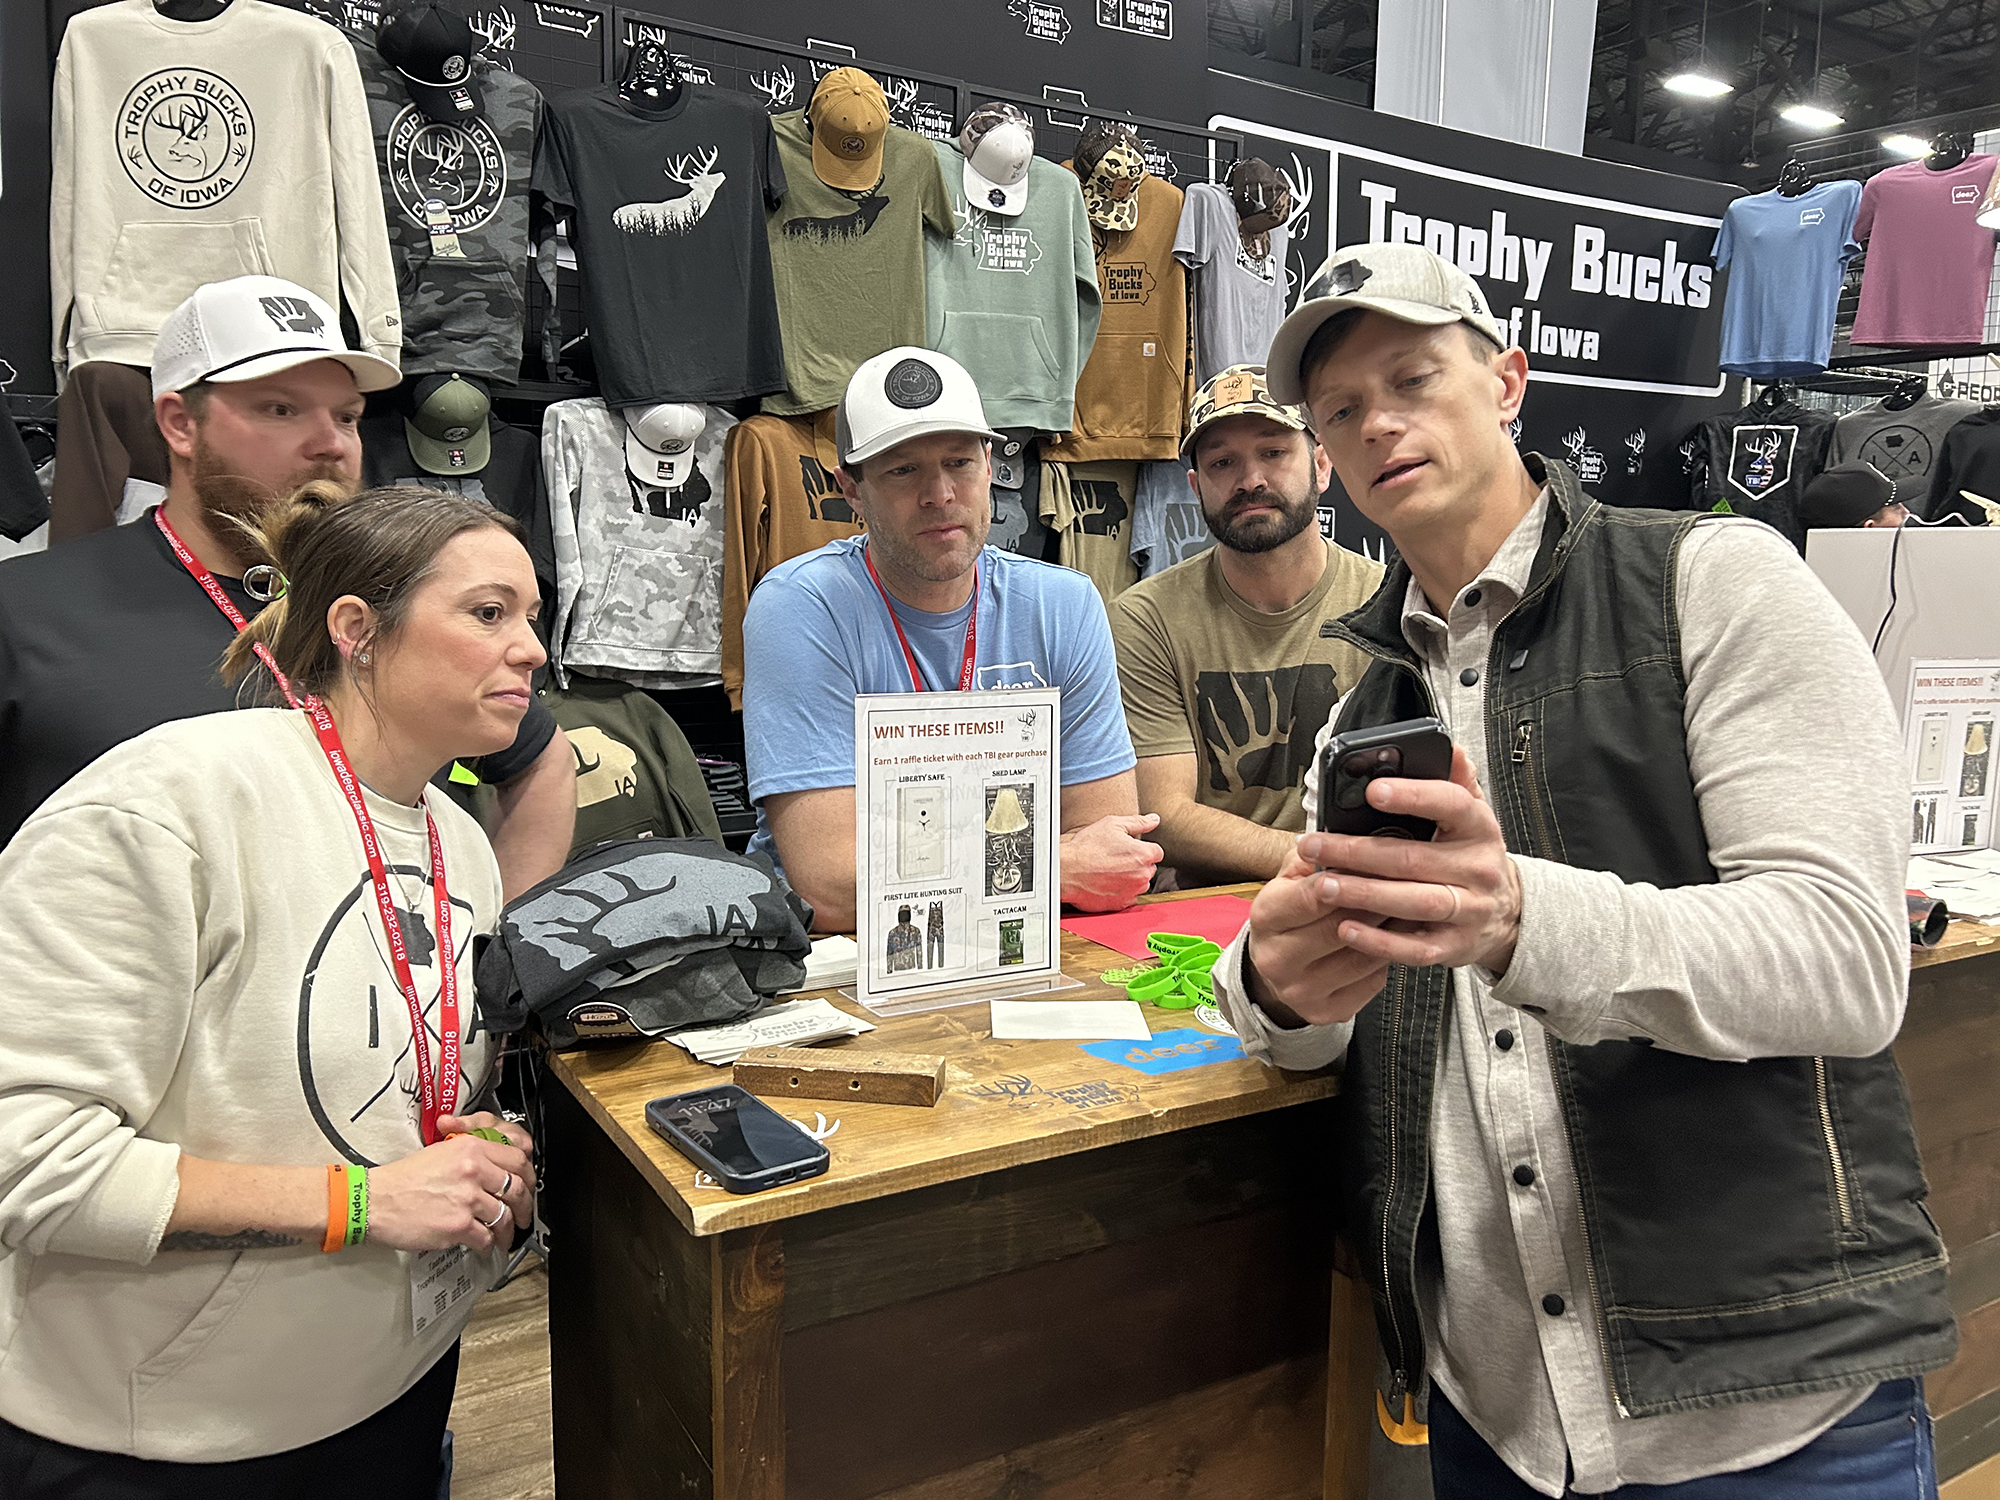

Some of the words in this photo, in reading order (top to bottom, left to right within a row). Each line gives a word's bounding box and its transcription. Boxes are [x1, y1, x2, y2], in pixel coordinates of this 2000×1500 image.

[1029, 4, 1060, 22] Trophy
[1127, 10, 1165, 30] Bucks
[1032, 15, 1060, 30] Bucks
[1033, 26, 1041, 34] of
[125, 76, 187, 138] TROPHY
[194, 78, 246, 136] BUCKS
[912, 111, 952, 132] Trophy
[148, 178, 176, 197] OF
[180, 177, 233, 202] IOWA
[983, 230, 1028, 247] Trophy
[1360, 180, 1553, 301] Trophy
[1571, 224, 1713, 310] Bucks
[987, 244, 1027, 258] Bucks
[988, 257, 998, 267] of
[1000, 257, 1023, 268] Iowa
[1103, 266, 1143, 279] Trophy
[1109, 279, 1143, 290] Bucks
[1110, 291, 1119, 300] of
[1121, 290, 1140, 300] Iowa
[1529, 310, 1600, 361] Iowa
[893, 365, 912, 387] TROPHY
[914, 366, 935, 384] BUCKS
[912, 393, 931, 401] IOWA
[682, 508, 698, 521] IA
[1107, 525, 1118, 536] IA
[1006, 538, 1017, 550] IA
[199, 572, 243, 624] 319-232-0218
[874, 726, 904, 739] WIN
[908, 723, 950, 738] THESE
[954, 720, 1004, 735] ITEMS!!
[874, 757, 891, 766] Earn
[894, 756, 899, 764] 1
[900, 754, 921, 764] raffle
[923, 754, 945, 763] ticket
[946, 752, 964, 761] with
[965, 751, 982, 760] each
[984, 751, 996, 760] TBI
[997, 752, 1014, 761] gear
[1015, 749, 1047, 759] purchase
[899, 774, 927, 783] LIBERTY
[928, 773, 945, 781] SAFE
[992, 769, 1008, 777] SHED
[1009, 768, 1027, 776] LAMP
[614, 776, 636, 795] IA
[328, 750, 377, 858] iowadeerclassic.com
[884, 893, 903, 901] FIRST
[920, 889, 947, 898] HUNTING
[948, 887, 963, 895] SUIT
[993, 906, 1027, 916] TACTACAM
[377, 882, 406, 961] 319-232-0218
[705, 904, 752, 936] IA
[439, 900, 455, 1007] iowadeerclassic.com
[405, 985, 434, 1110] illinoisdeerclassic.com
[1124, 1039, 1221, 1063] deer
[441, 1031, 457, 1111] 319-232-0218
[1043, 1083, 1108, 1098] Trophy
[1061, 1089, 1119, 1104] Bucks
[679, 1098, 730, 1116] 11:47
[1076, 1101, 1090, 1109] of
[1088, 1096, 1124, 1106] Iowa
[352, 1182, 363, 1223] Trophy
